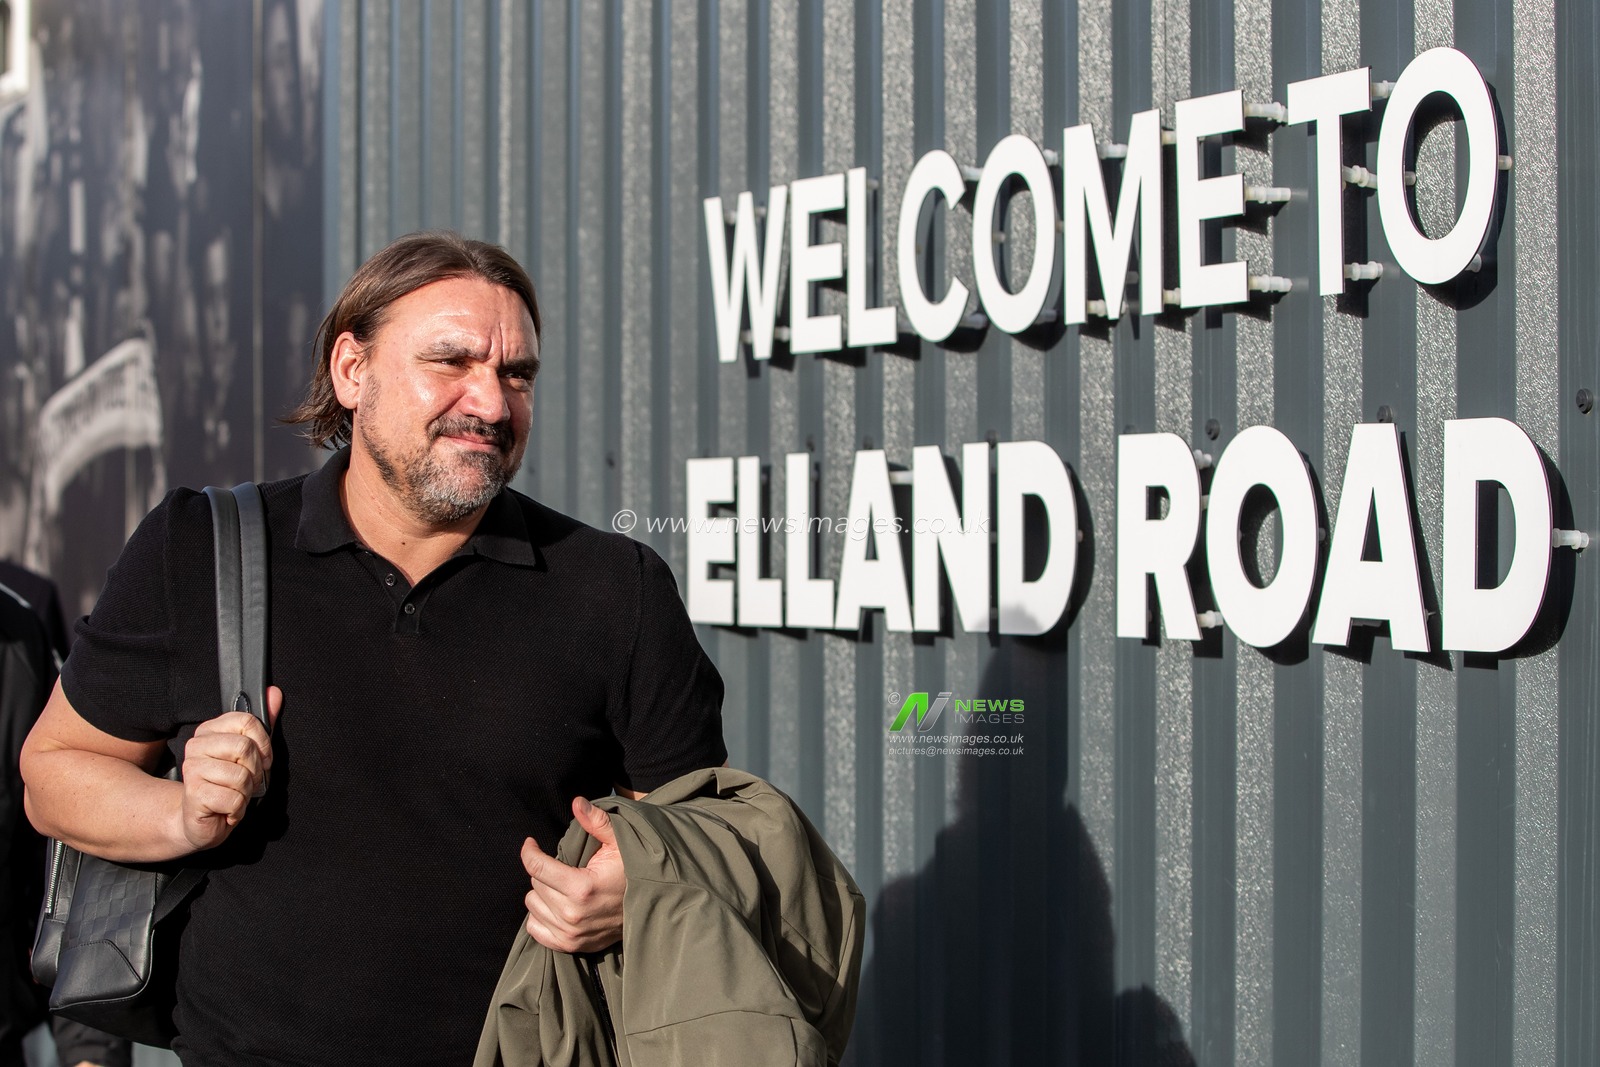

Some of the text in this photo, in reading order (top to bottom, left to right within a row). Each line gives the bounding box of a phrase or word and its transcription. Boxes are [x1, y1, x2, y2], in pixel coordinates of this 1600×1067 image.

[704, 47, 1499, 363] WELCOME TO
[686, 417, 1554, 653] ELLAND ROAD
